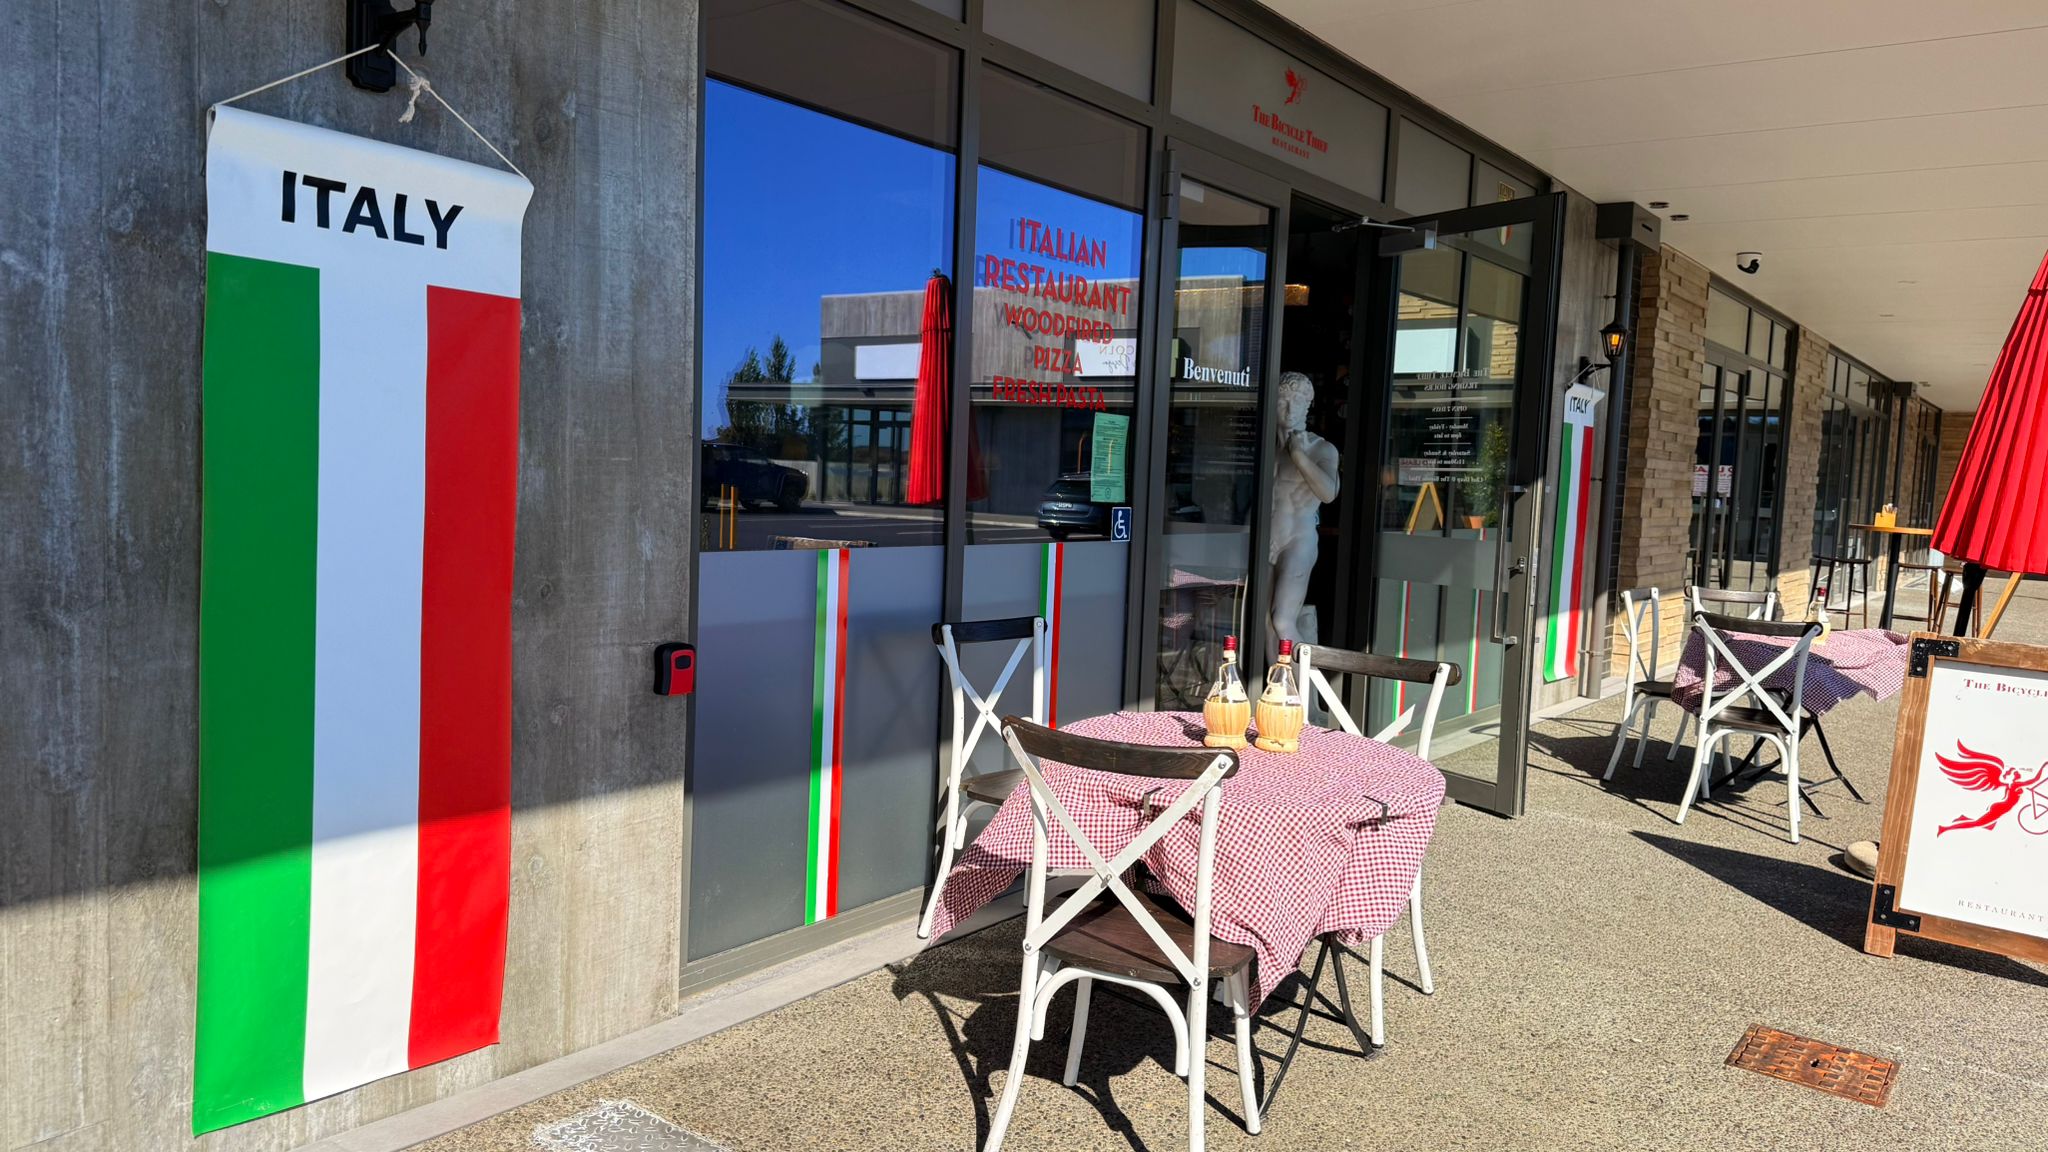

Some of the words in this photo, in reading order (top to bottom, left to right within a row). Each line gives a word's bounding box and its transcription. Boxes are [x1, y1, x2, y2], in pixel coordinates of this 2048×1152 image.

[282, 170, 464, 250] ITALY
[1019, 217, 1107, 269] ITALIAN
[985, 254, 1132, 316] RESTAURANT
[1004, 302, 1115, 345] WOODFIRED
[1034, 345, 1083, 374] PIZZA
[1183, 357, 1251, 387] Benvenuti
[992, 375, 1051, 407] FRESH
[1057, 383, 1106, 411] PASTA
[1569, 396, 1590, 414] ITALY
[1958, 899, 2044, 922] RESTAURANT
